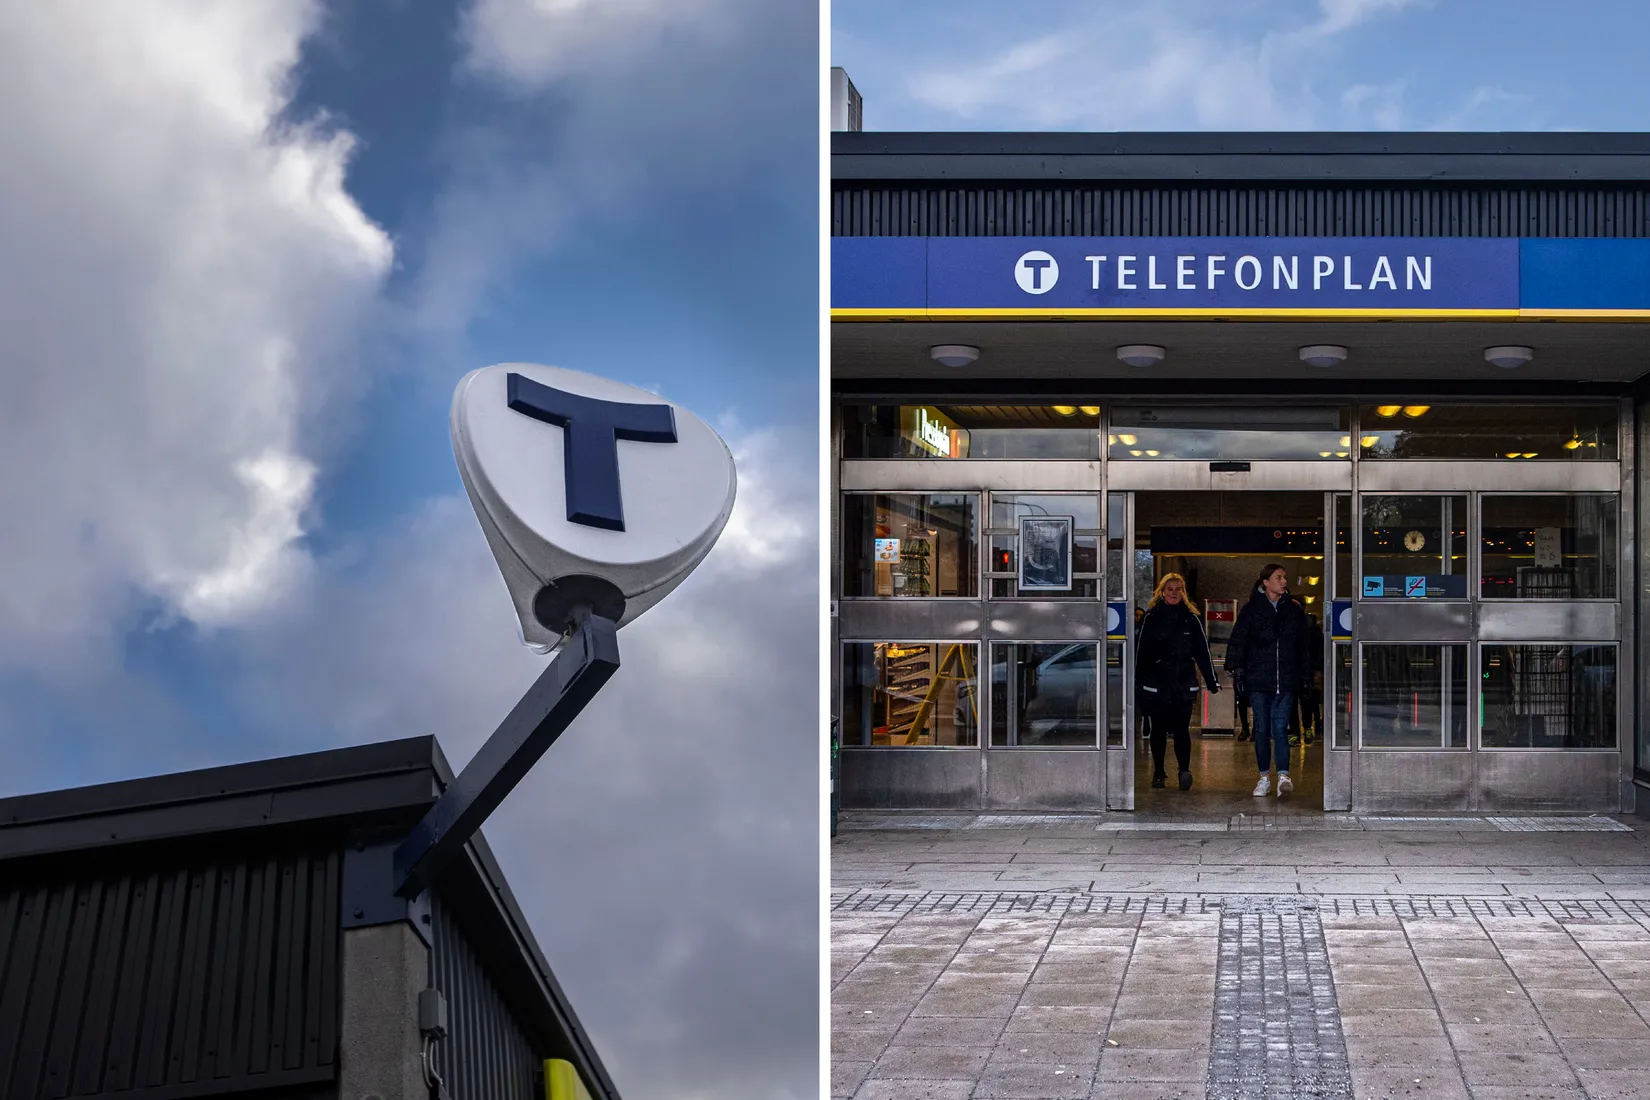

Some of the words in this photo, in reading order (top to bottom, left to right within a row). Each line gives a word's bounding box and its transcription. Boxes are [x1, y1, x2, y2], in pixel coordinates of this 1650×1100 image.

[1024, 259, 1051, 290] T
[1085, 255, 1432, 290] TELEFONPLAN
[507, 372, 678, 532] T
